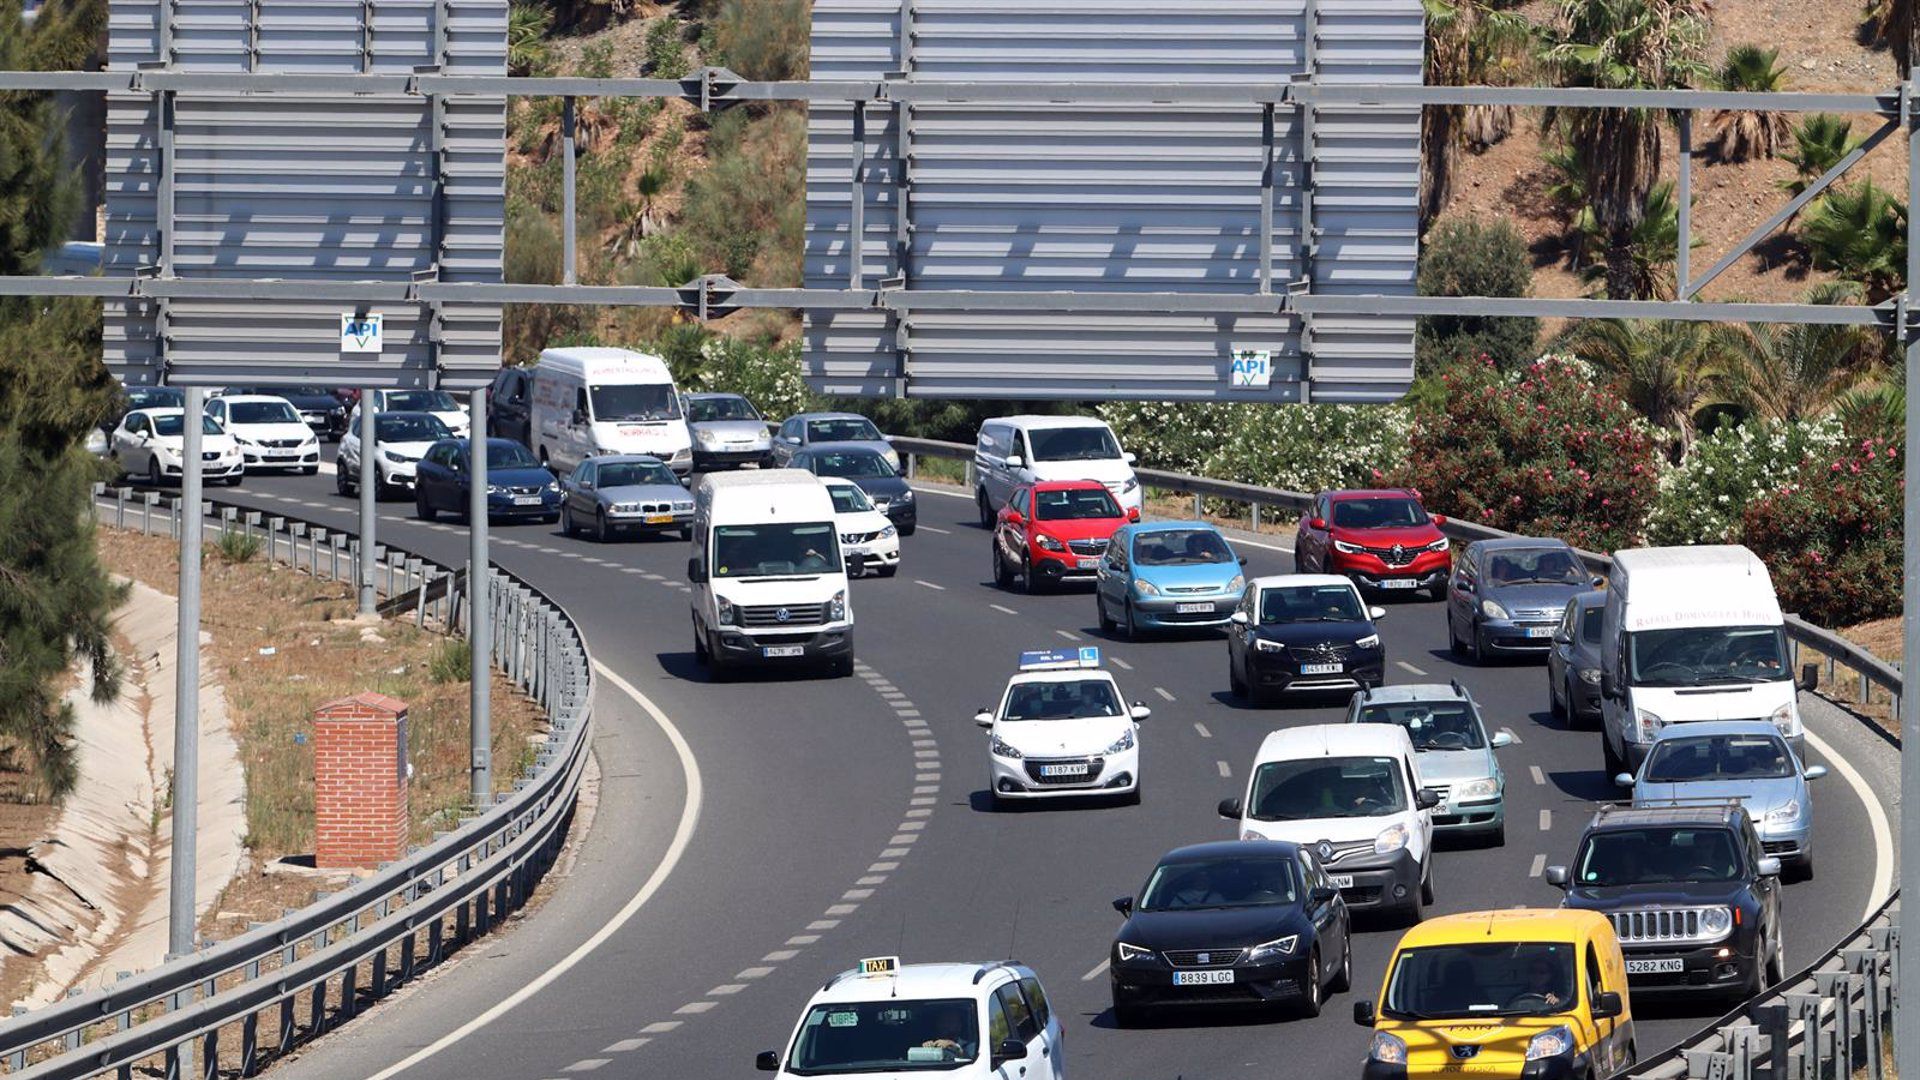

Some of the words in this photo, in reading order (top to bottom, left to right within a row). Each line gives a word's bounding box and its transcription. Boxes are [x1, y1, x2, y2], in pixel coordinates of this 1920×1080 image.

[345, 322, 377, 336] API
[1231, 359, 1265, 374] API
[1084, 650, 1093, 659] L
[867, 960, 888, 971] TAXI
[1630, 961, 1657, 972] 5282
[1660, 960, 1681, 971] KNG
[1181, 973, 1208, 983] 8839
[1211, 972, 1231, 982] LGC
[831, 1013, 856, 1025] LIBRE
